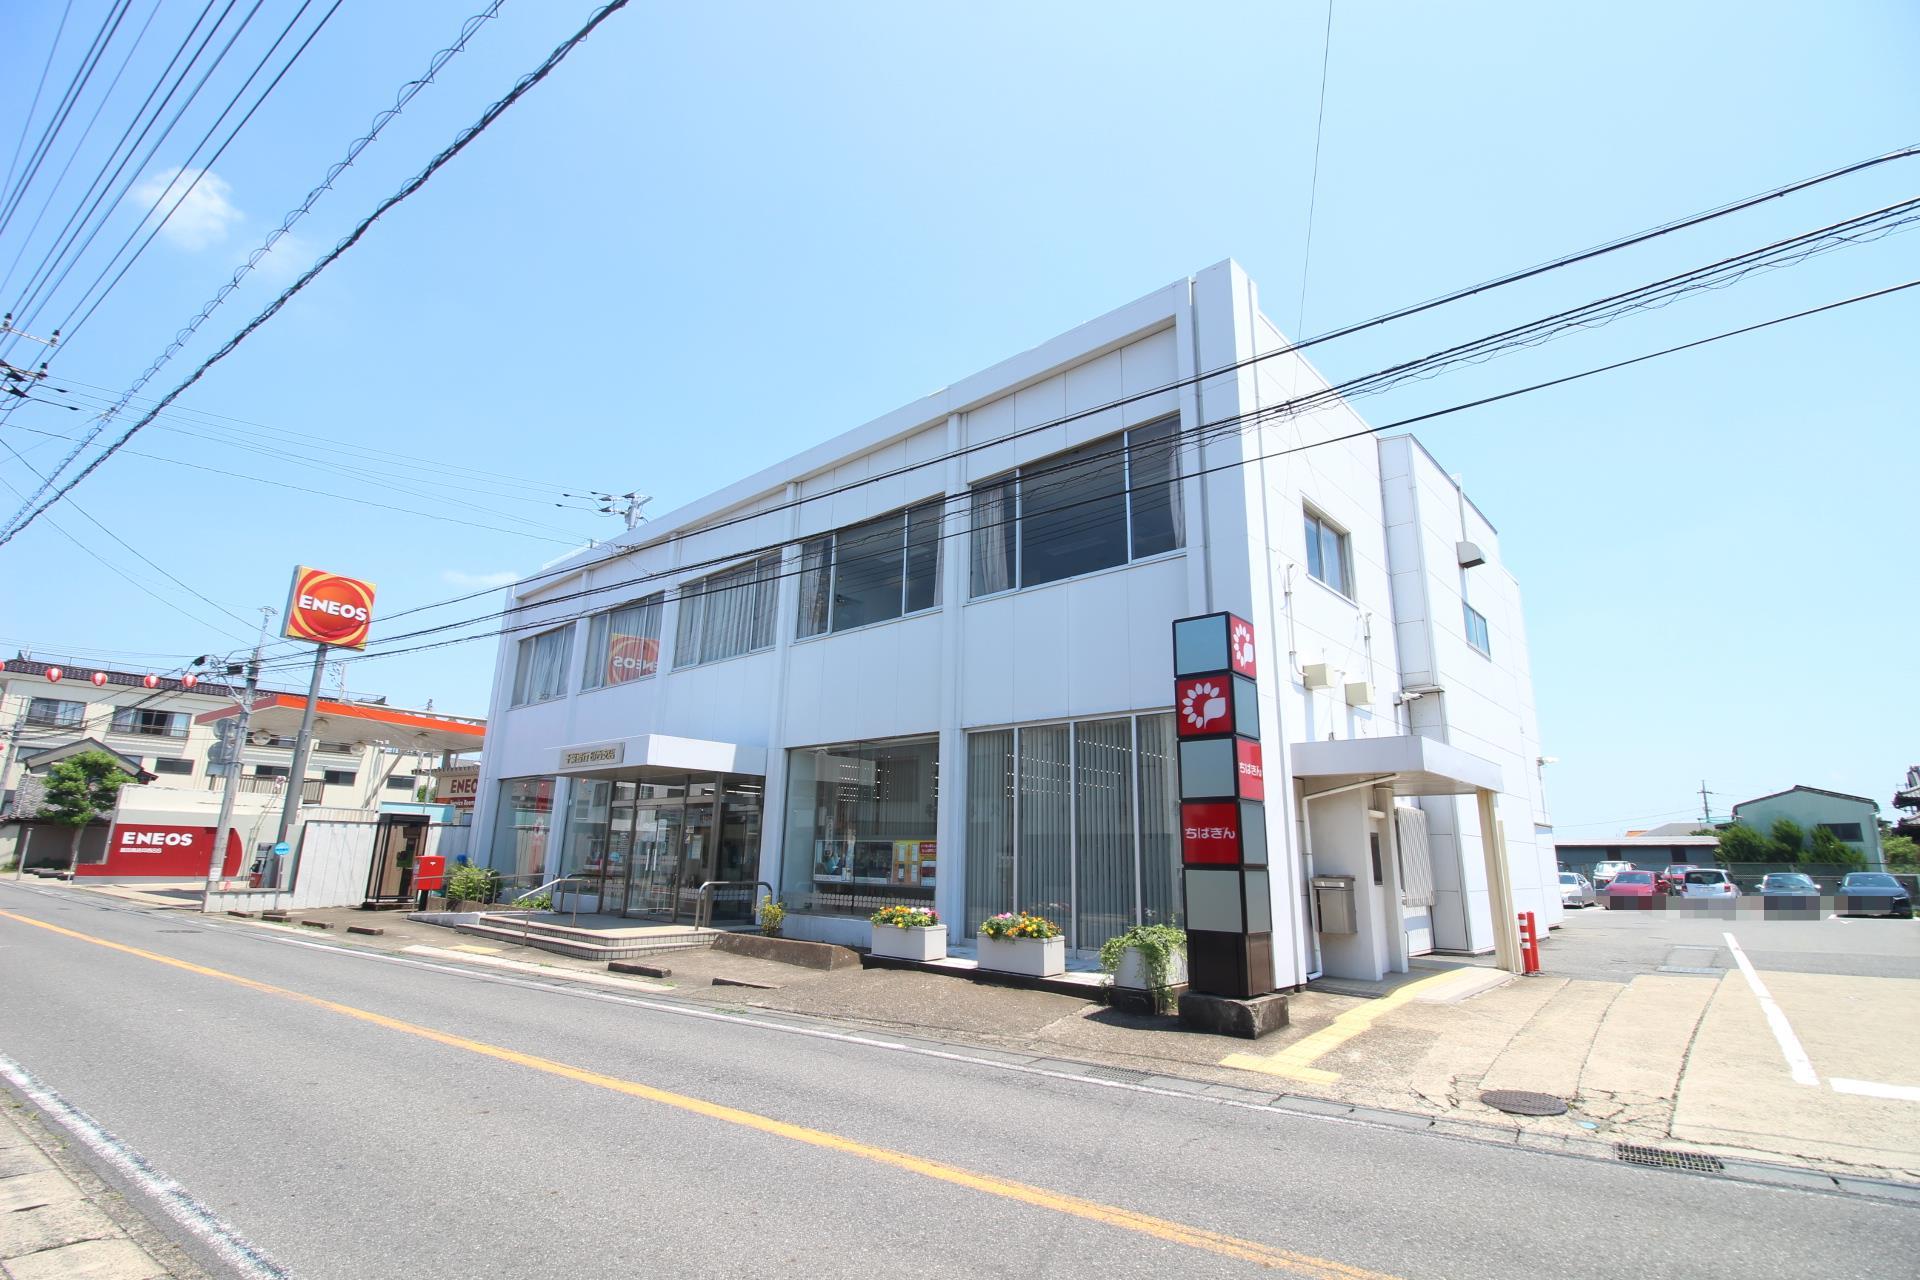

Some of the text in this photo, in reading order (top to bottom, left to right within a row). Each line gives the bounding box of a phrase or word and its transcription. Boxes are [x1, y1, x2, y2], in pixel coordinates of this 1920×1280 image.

[299, 595, 367, 622] ENEOS
[121, 831, 193, 847] ENEOS
[1184, 827, 1236, 839] ちばぎん
